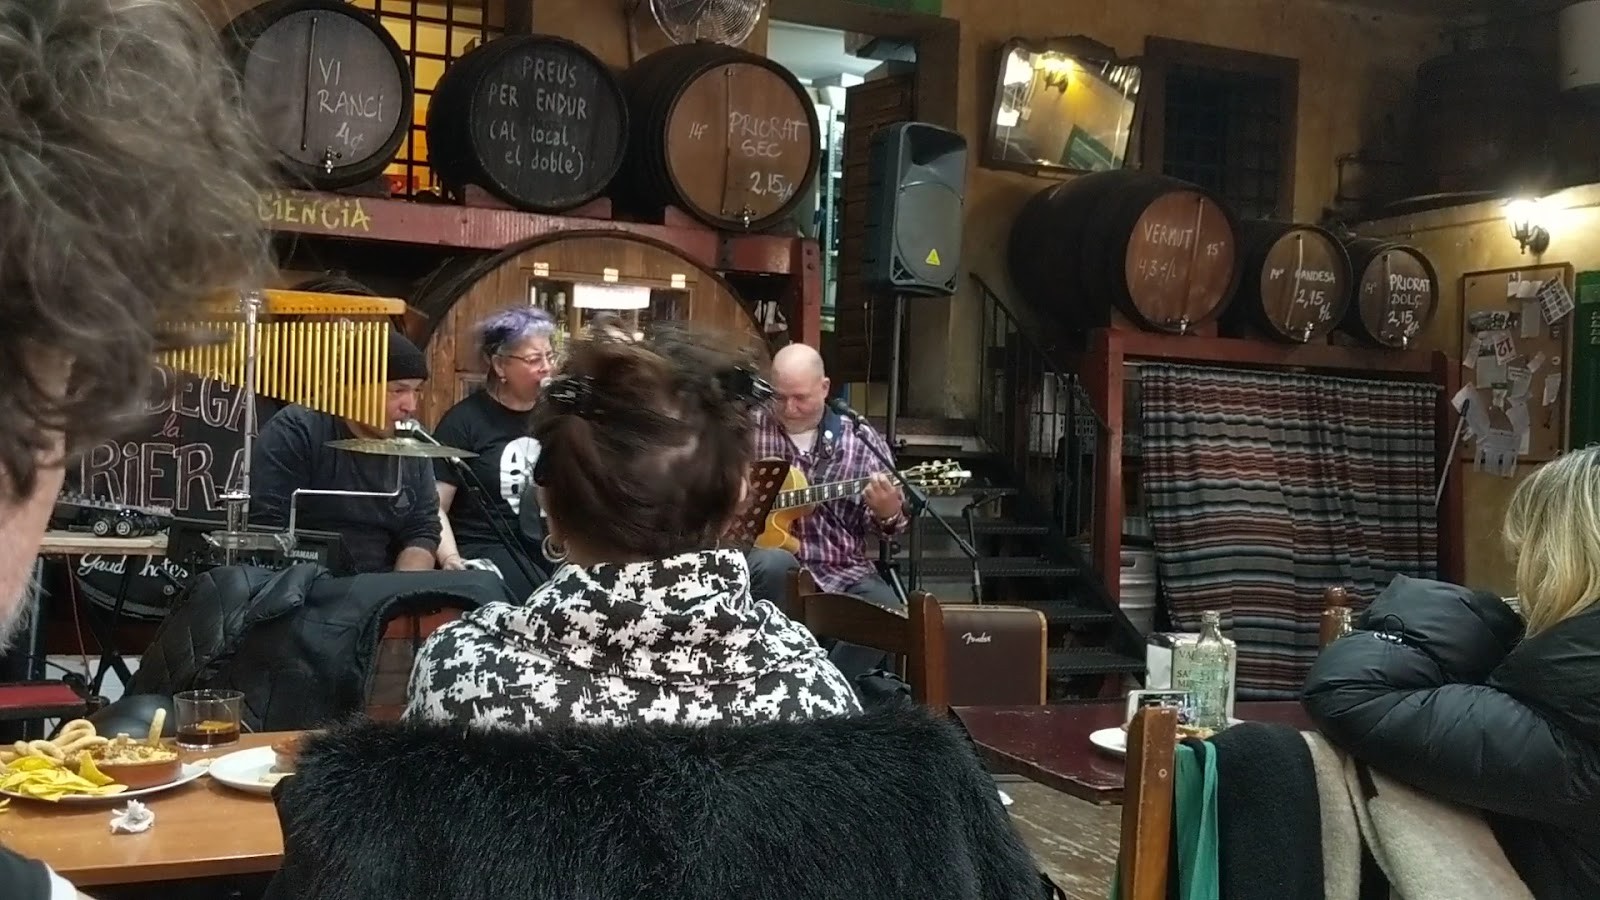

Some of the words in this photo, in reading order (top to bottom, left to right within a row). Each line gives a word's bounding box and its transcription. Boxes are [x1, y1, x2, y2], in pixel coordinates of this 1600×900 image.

[318, 57, 341, 86] VI
[521, 55, 577, 89] PREUS
[488, 82, 519, 107] PER
[536, 87, 587, 120] ENDUR
[729, 111, 809, 142] PRIORAT
[504, 145, 521, 166] el
[740, 139, 782, 158] SEC
[1144, 221, 1193, 250] VERMUT
[1389, 273, 1431, 293] PRIORAT
